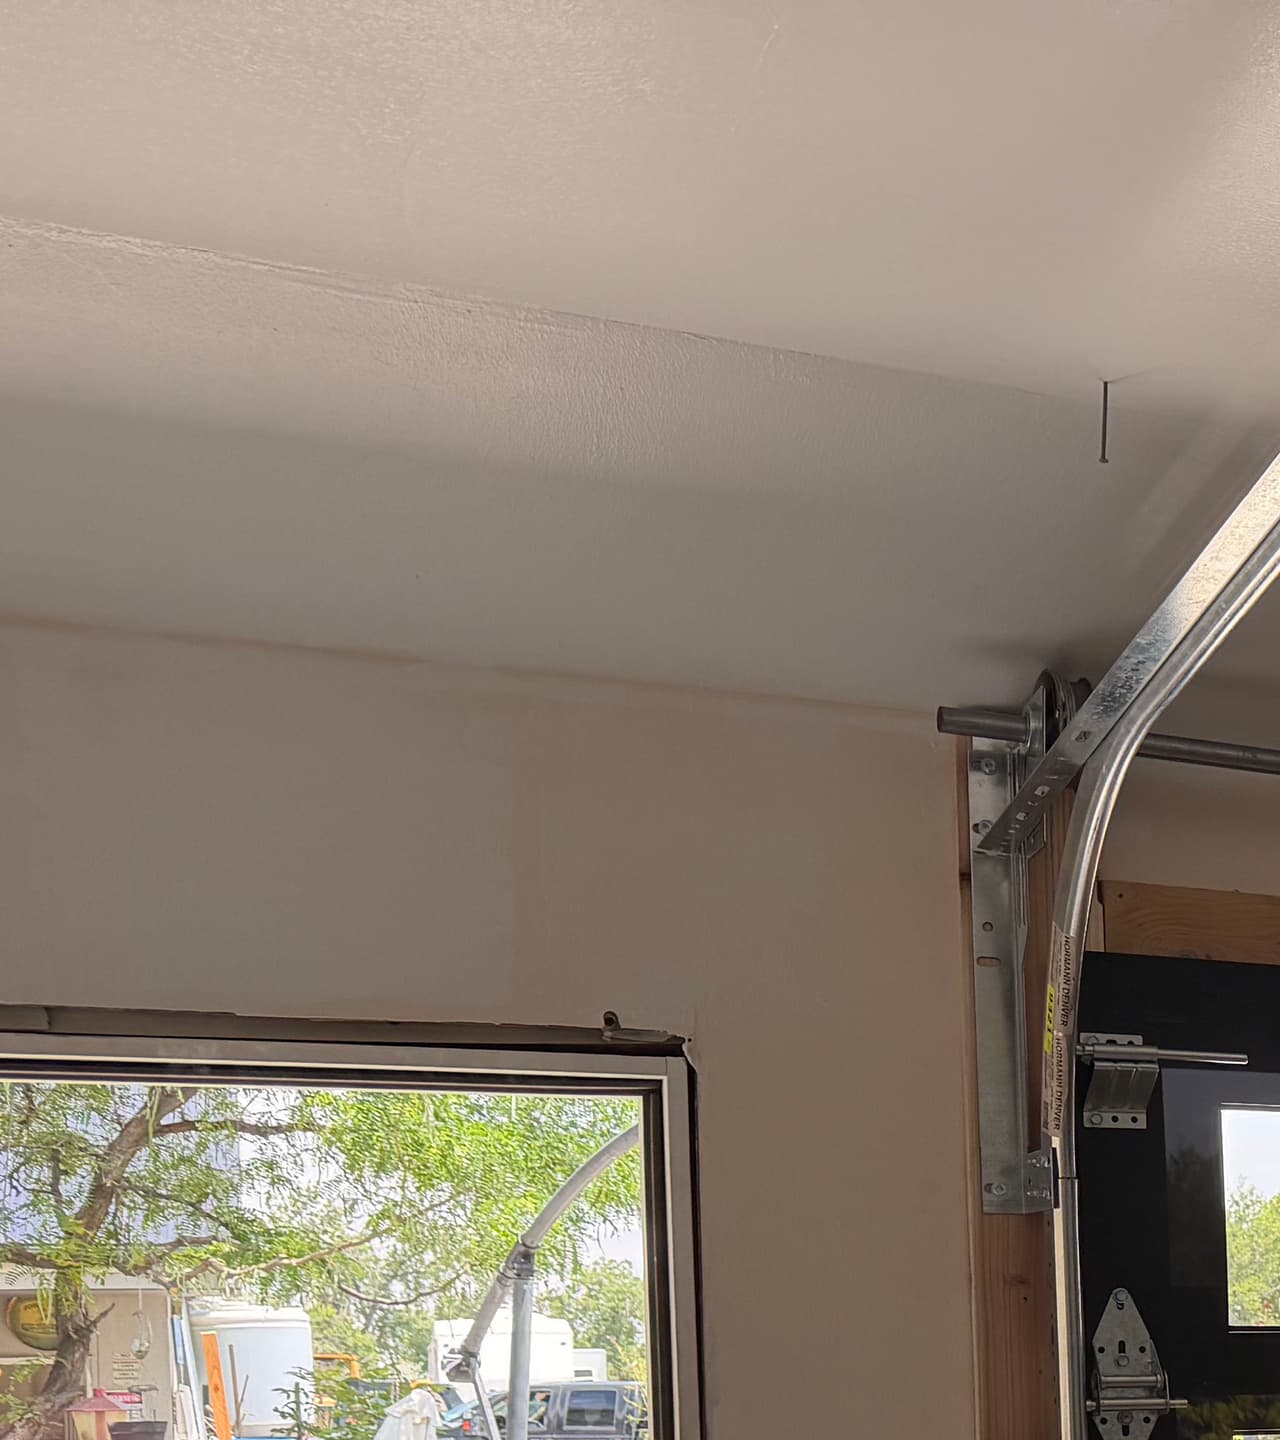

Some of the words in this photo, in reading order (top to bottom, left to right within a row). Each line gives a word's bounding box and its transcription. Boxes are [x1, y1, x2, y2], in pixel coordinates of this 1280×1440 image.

[1061, 935, 1072, 985] HORMANN
[1059, 987, 1072, 1027] DENVER
[1054, 1038, 1065, 1088] HORMANN
[1052, 1090, 1064, 1130] DENVER
